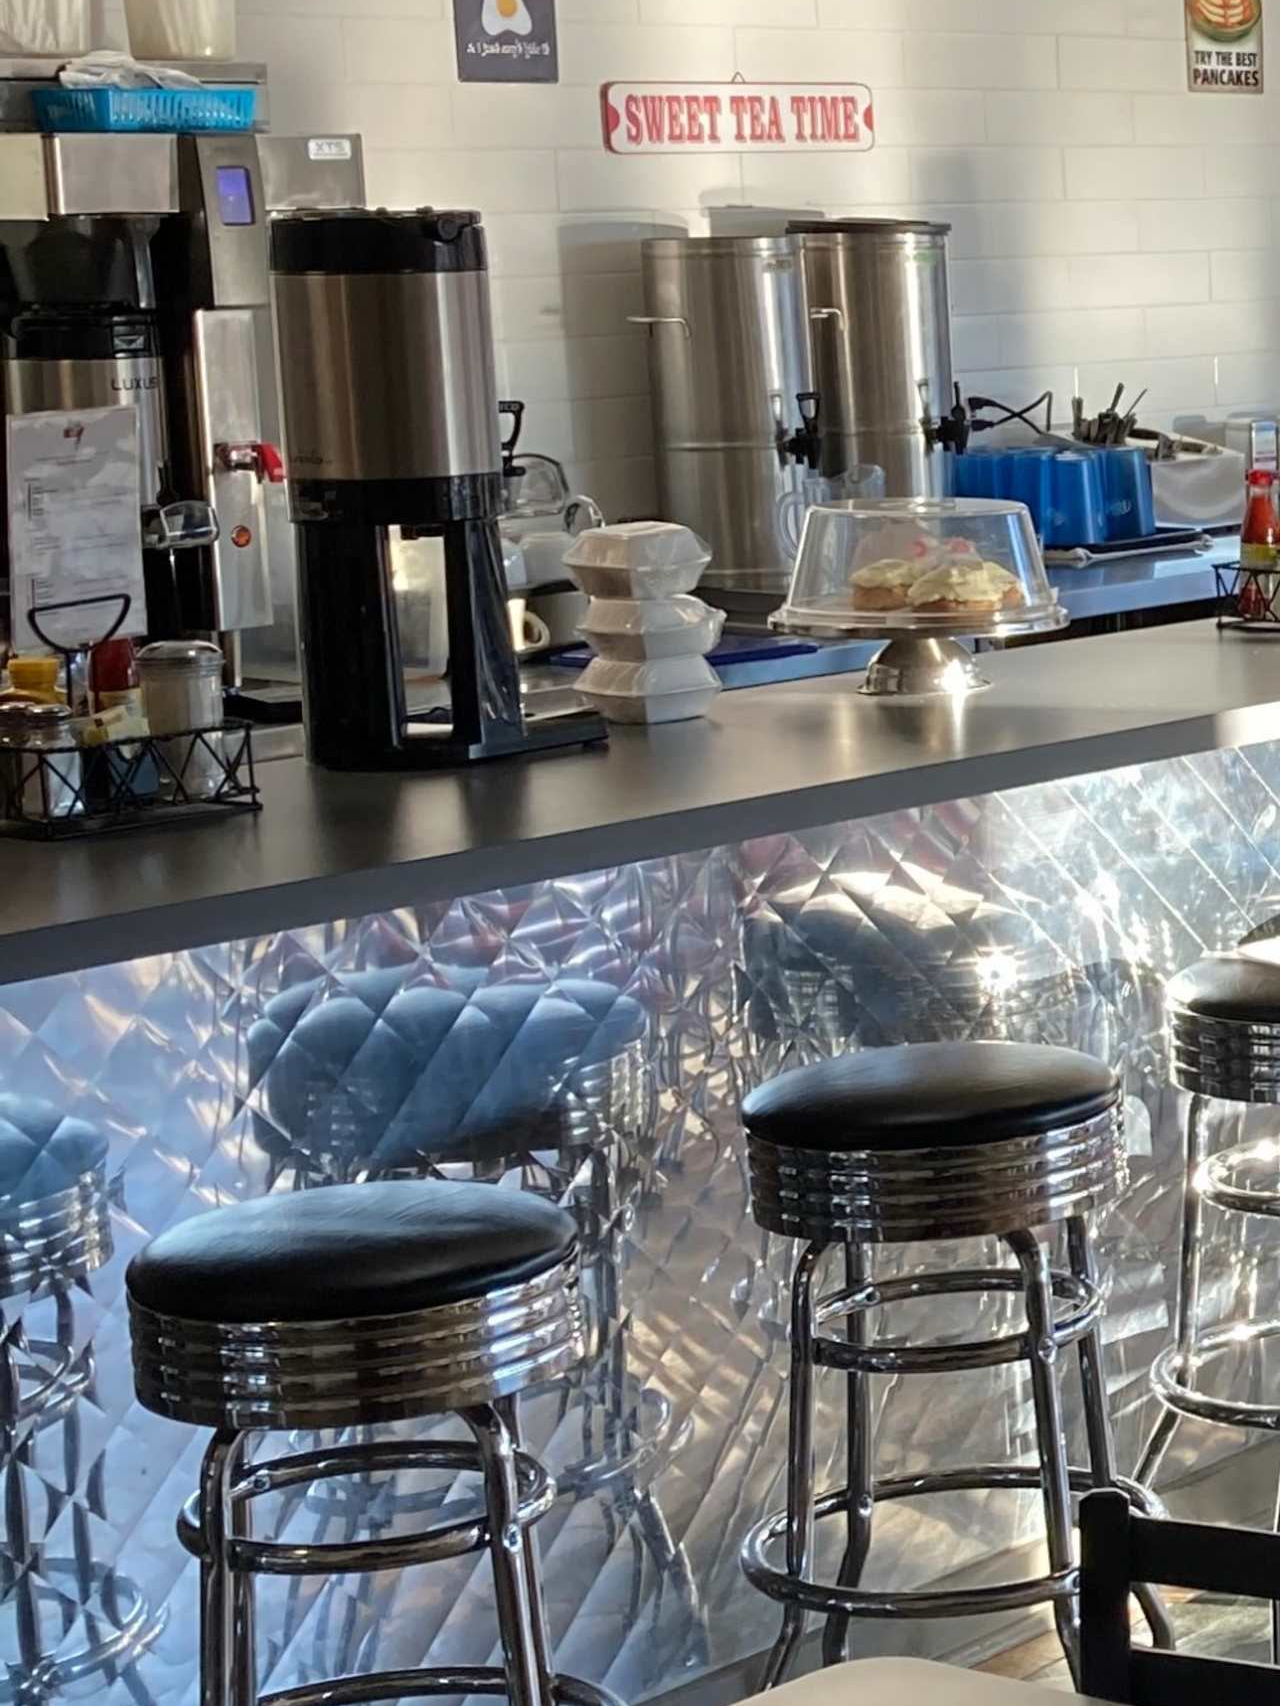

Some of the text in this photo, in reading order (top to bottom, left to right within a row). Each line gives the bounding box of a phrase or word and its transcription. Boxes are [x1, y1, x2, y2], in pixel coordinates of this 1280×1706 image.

[1194, 50, 1258, 68] TRY THE BEST
[1193, 68, 1260, 86] PANCAKES
[624, 93, 860, 145] SWEET TEA TIME
